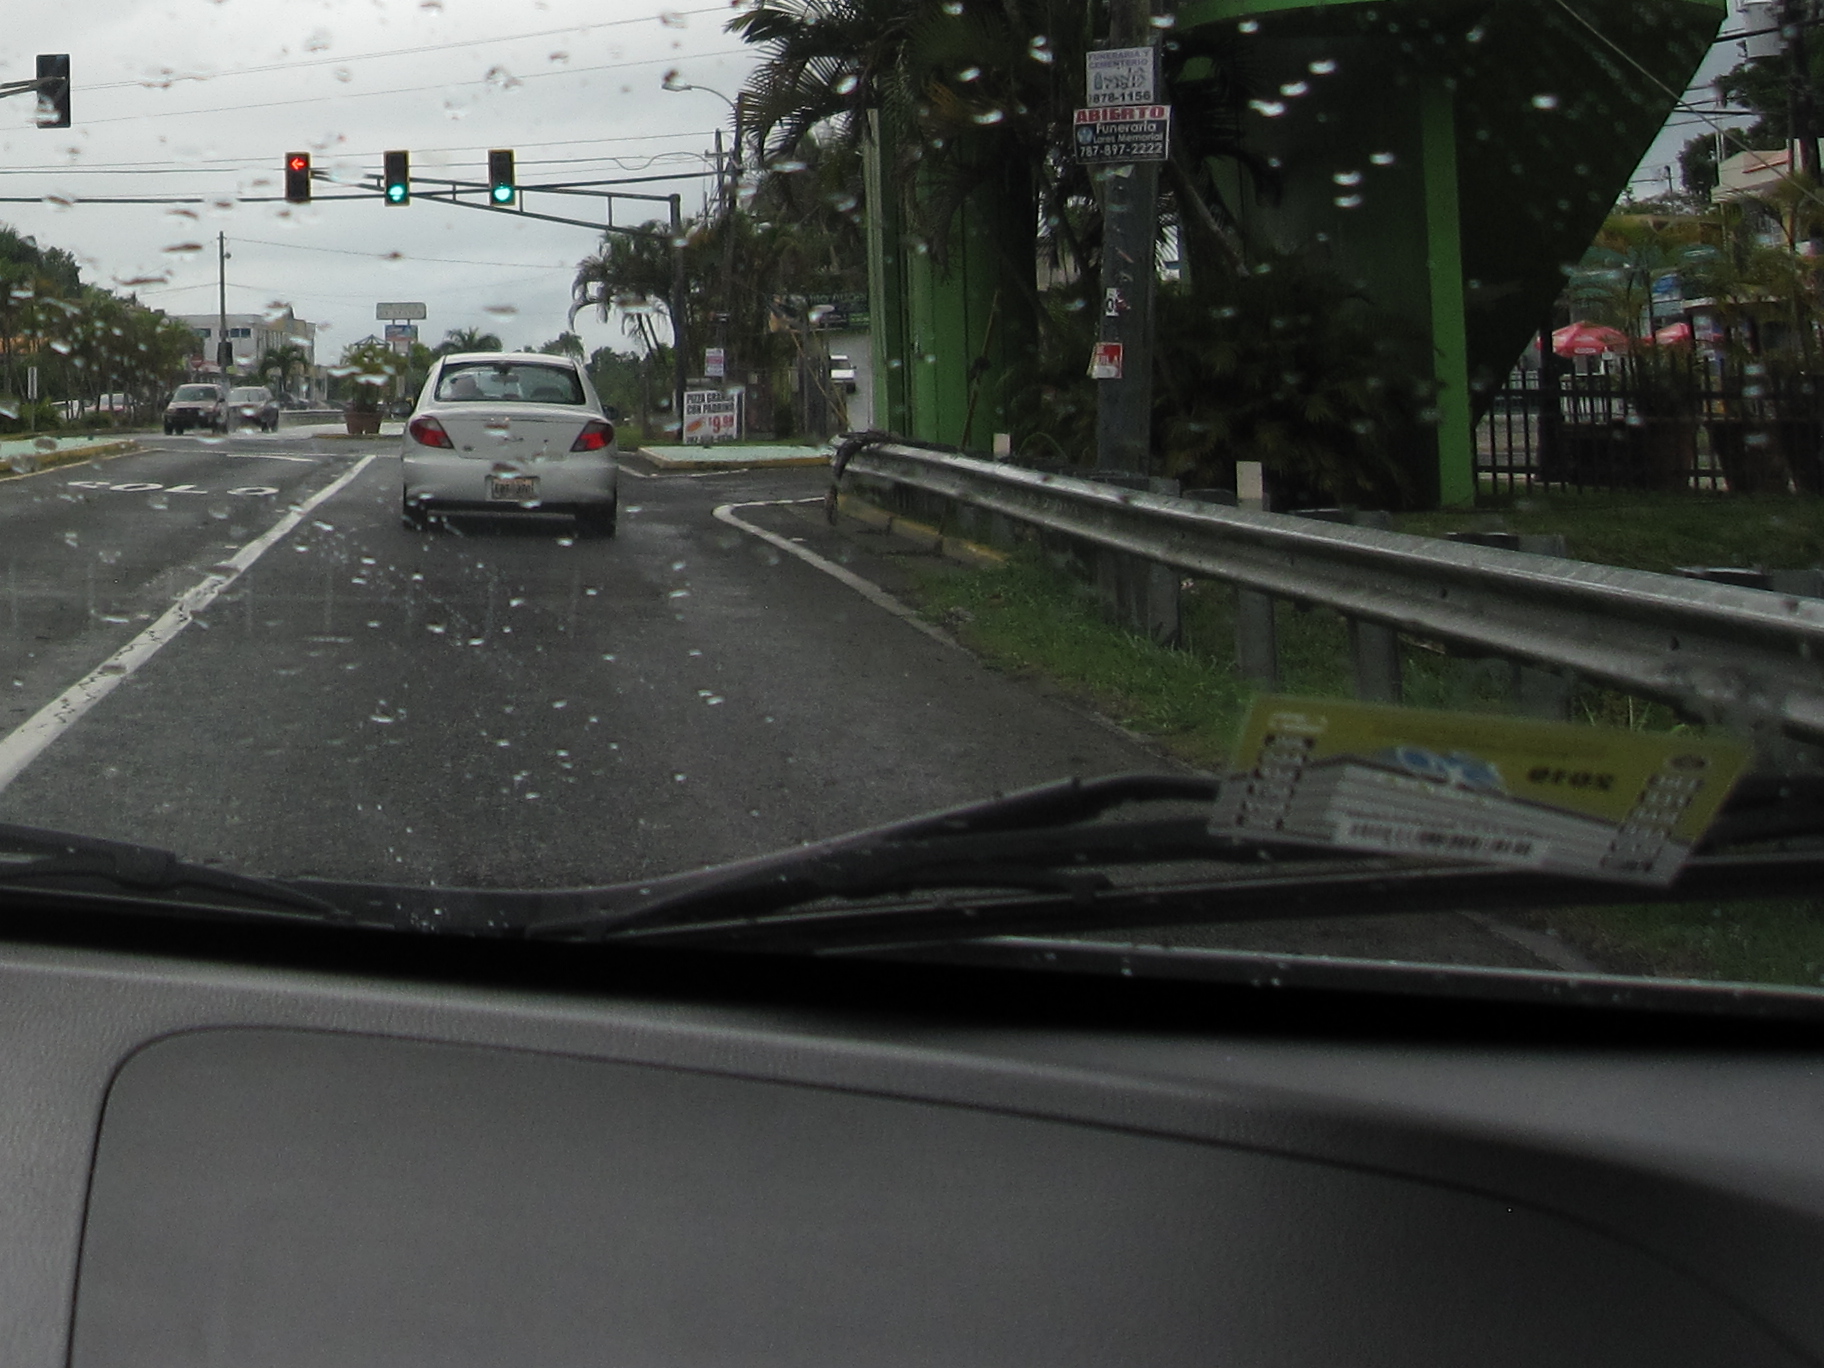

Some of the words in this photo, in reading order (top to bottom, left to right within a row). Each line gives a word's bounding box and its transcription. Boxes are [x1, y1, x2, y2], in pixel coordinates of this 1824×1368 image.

[1076, 107, 1165, 123] ABIERTO
[1096, 120, 1157, 134] Funeraria
[1080, 143, 1163, 157] 787-897-2222
